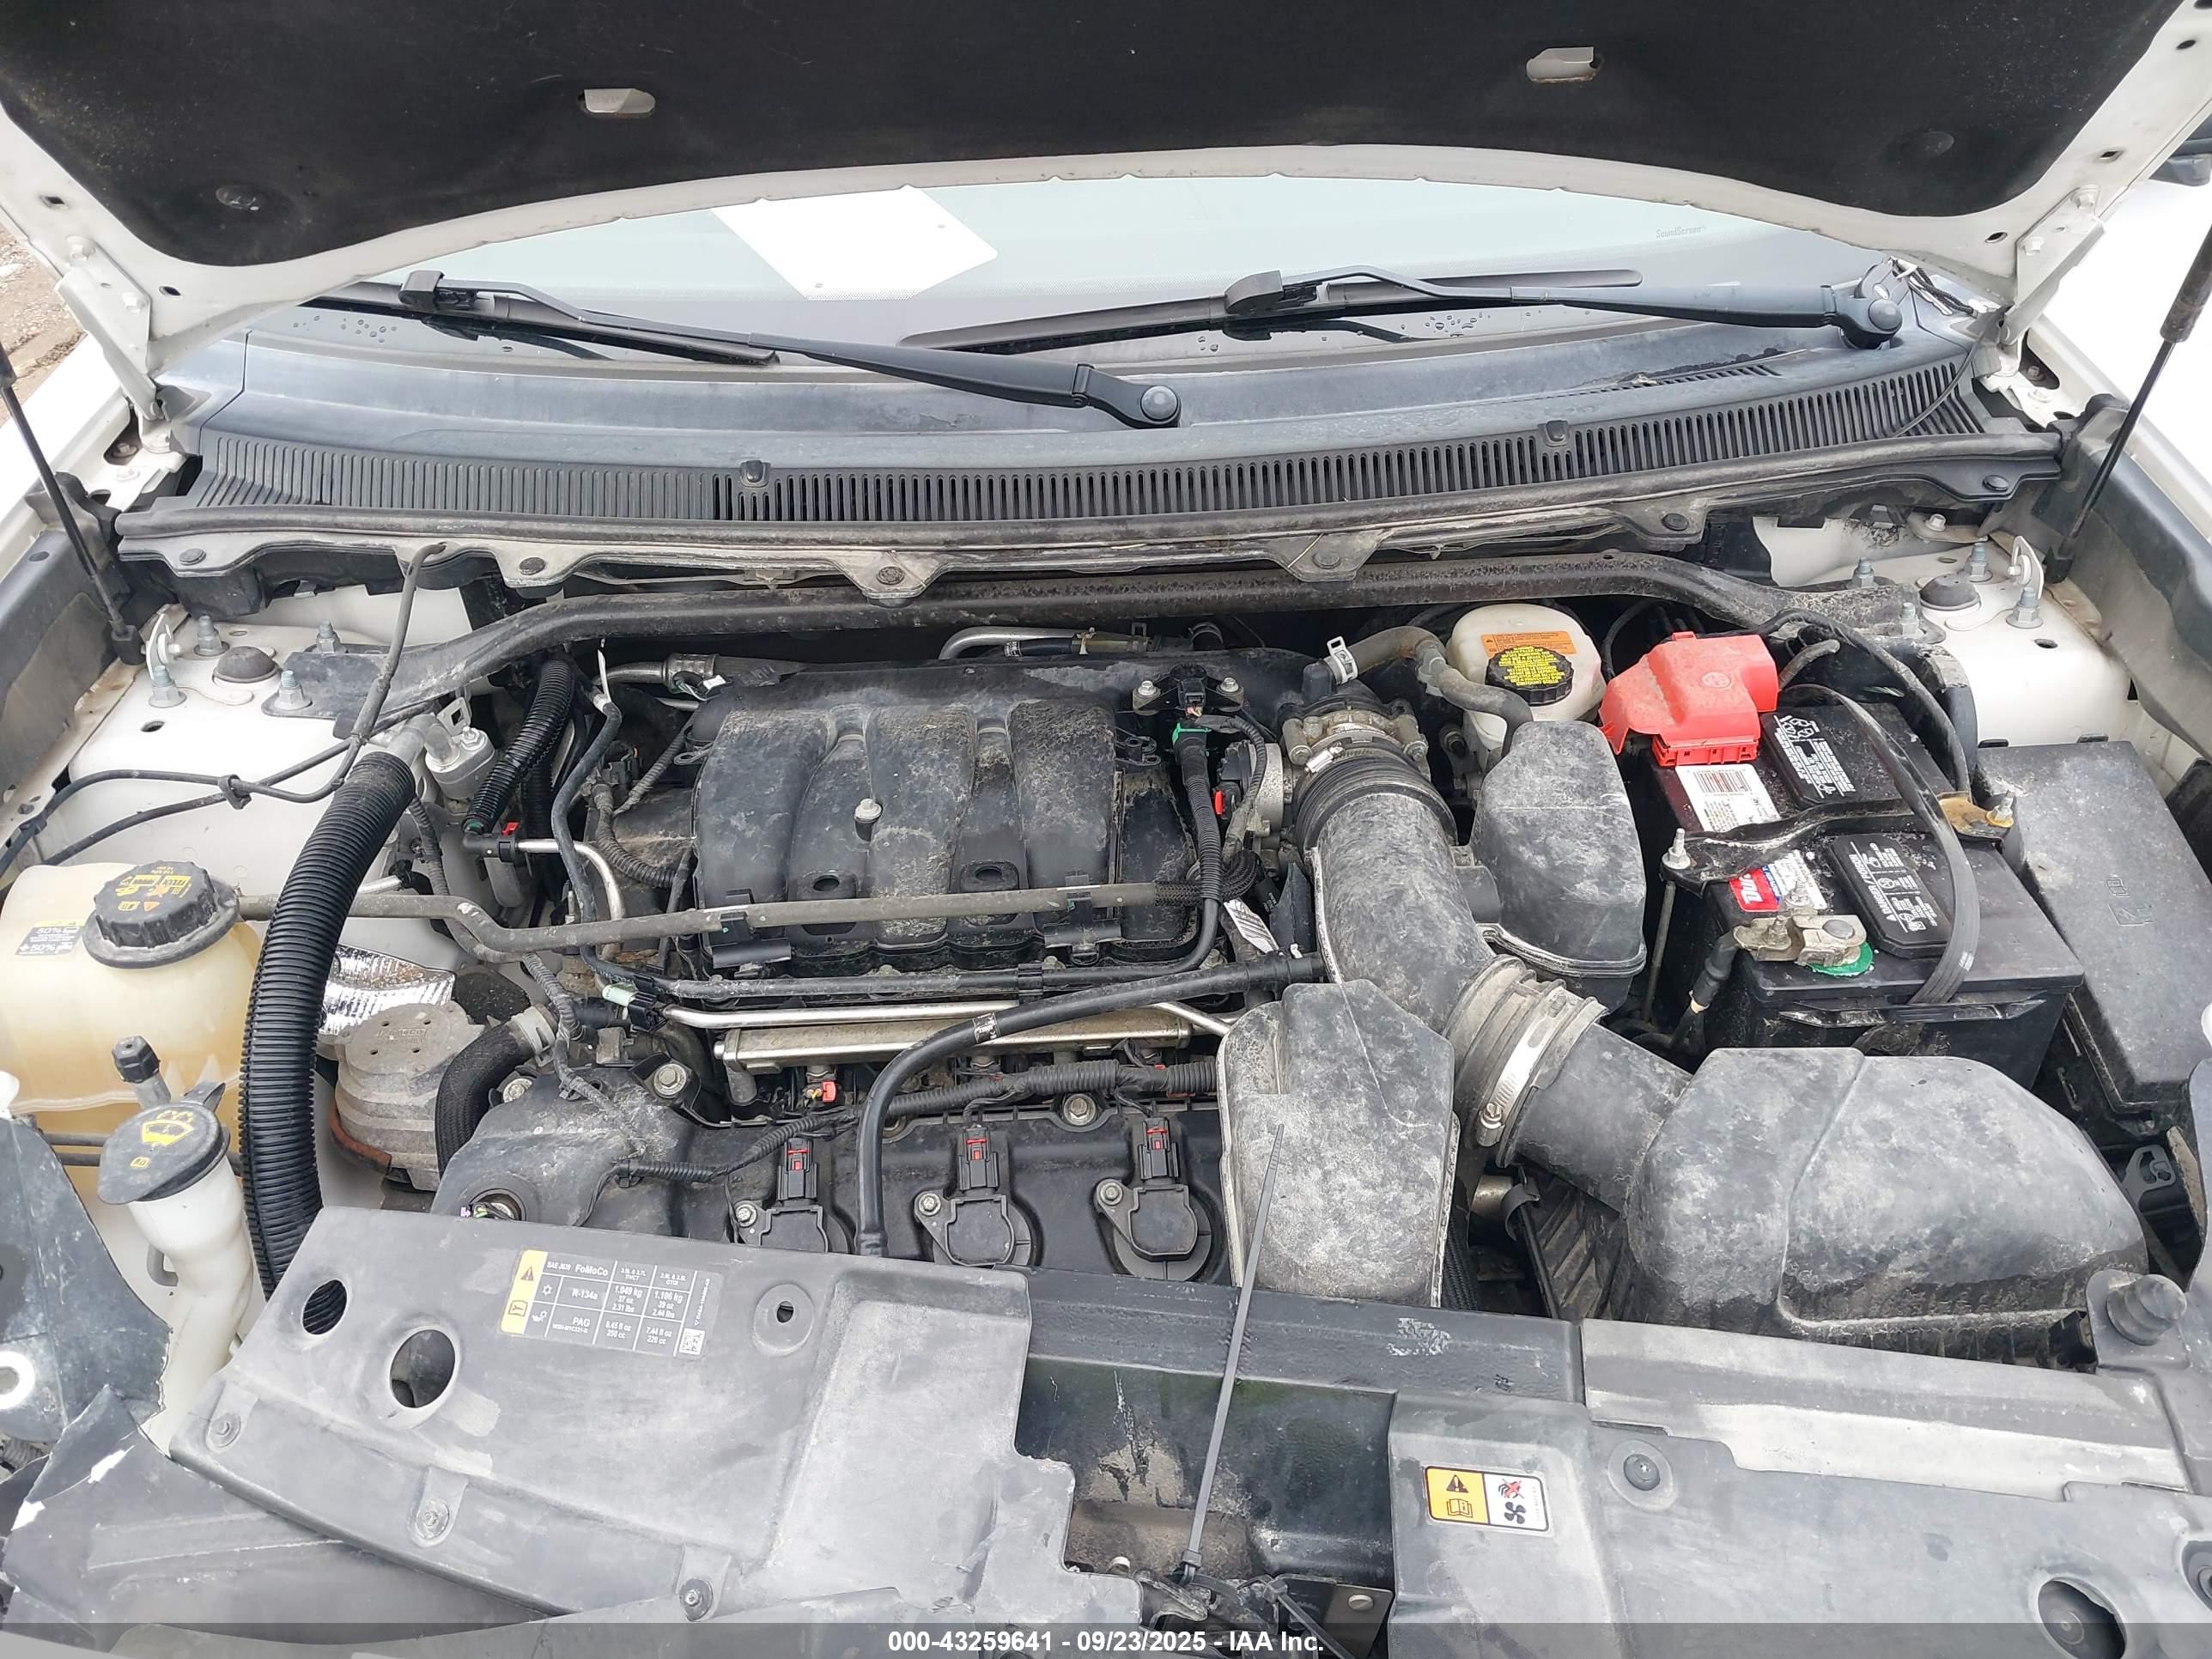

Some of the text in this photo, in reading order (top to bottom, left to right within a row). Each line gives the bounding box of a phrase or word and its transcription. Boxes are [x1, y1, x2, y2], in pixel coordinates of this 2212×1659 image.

[547, 1261, 559, 1269] SAE
[575, 1264, 608, 1276] FoMoCo
[571, 1288, 599, 1300] R-134a
[615, 1285, 643, 1299] 1.049 kg
[654, 1290, 683, 1304] 1.106 kg
[625, 1304, 635, 1313] lbs
[665, 1310, 675, 1319] lbs
[572, 1317, 590, 1328] PAG
